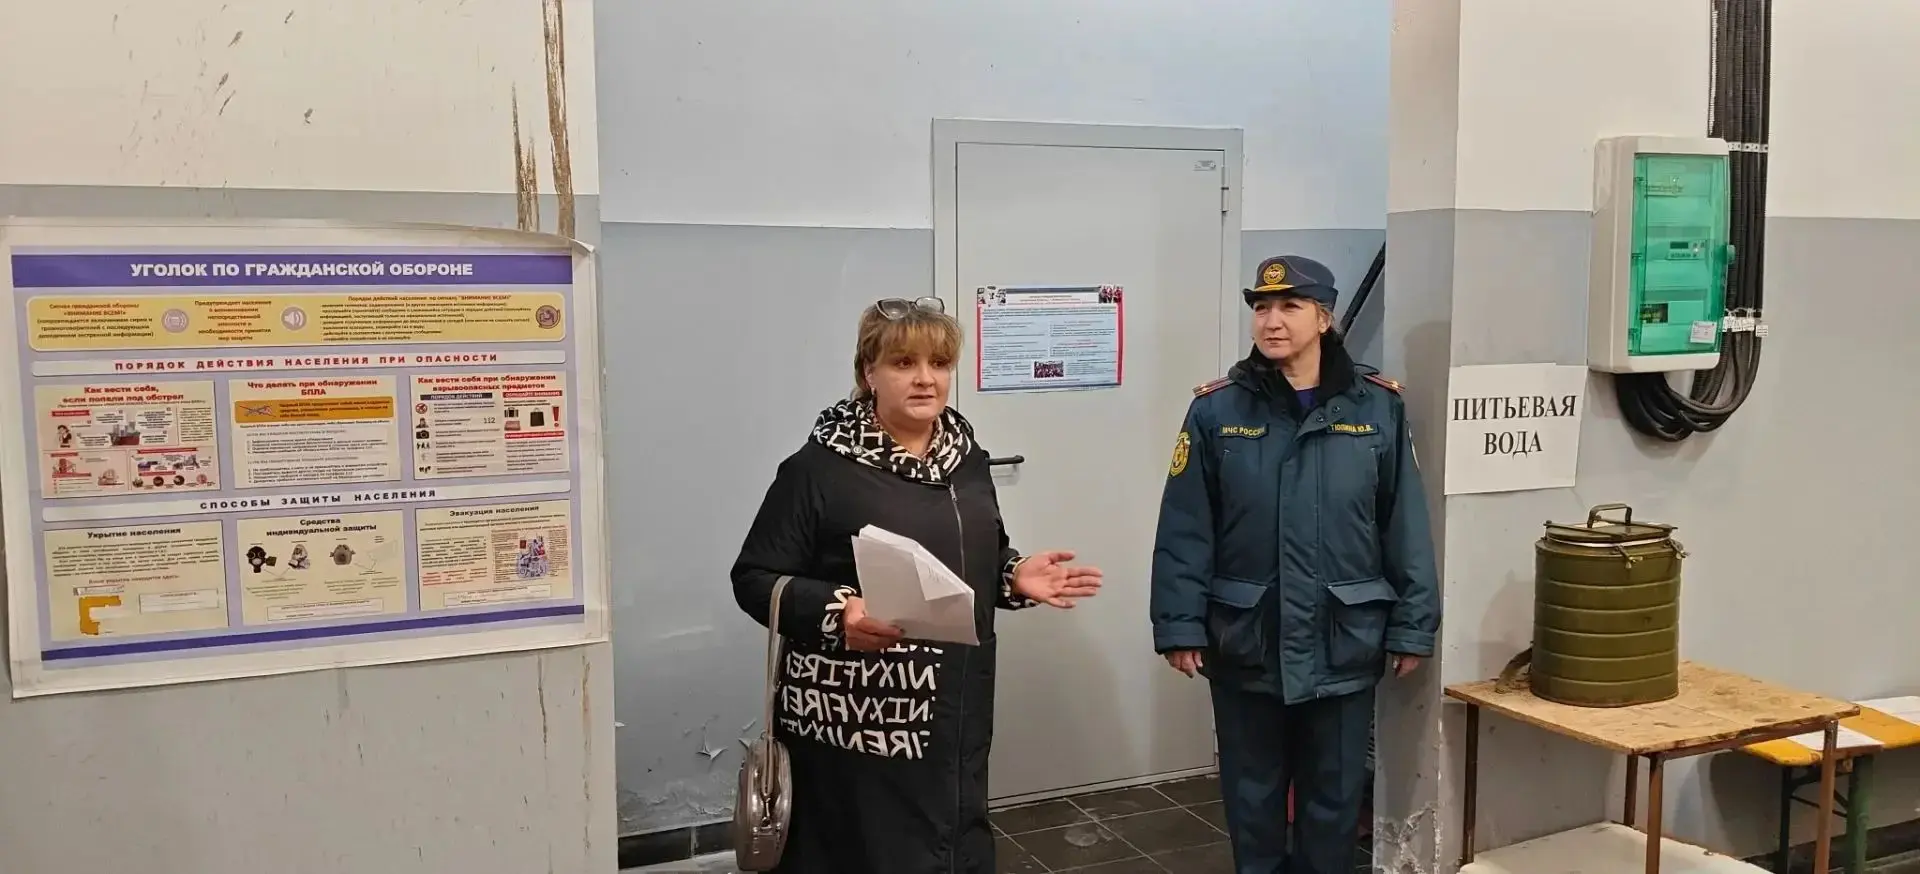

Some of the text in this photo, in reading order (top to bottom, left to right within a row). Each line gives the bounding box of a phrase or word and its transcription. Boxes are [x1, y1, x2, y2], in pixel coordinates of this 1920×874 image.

[130, 261, 474, 278] УГОЛОК ПО ГРАЖДАНСКОЙ ОБОРОНЕ
[115, 354, 497, 371] ПОРЯДОК ДЕЙСТВИЯ НАСЕЛЕНИЯ ПРИ ОПАСНОСТИ
[500, 374, 556, 382] обнаружении
[318, 380, 378, 388] обнаружении
[432, 383, 546, 392] взрывоопасных предметов
[84, 386, 102, 394] Как
[301, 388, 327, 396] БПЛА
[145, 393, 184, 402] обстрел
[1453, 395, 1578, 421] ПИТЬЕВАЯ
[1222, 426, 1238, 434] МЧС
[1482, 430, 1543, 459] ВОДА
[200, 489, 437, 510] СПОСОБЫ ЗАЩИТЫ НАСЕЛЕНИЯ
[449, 505, 540, 517] Эвакуация населения
[300, 518, 341, 526] Средства
[87, 528, 182, 540] Укрытие населения
[266, 524, 377, 536] индивидуальной защиты
